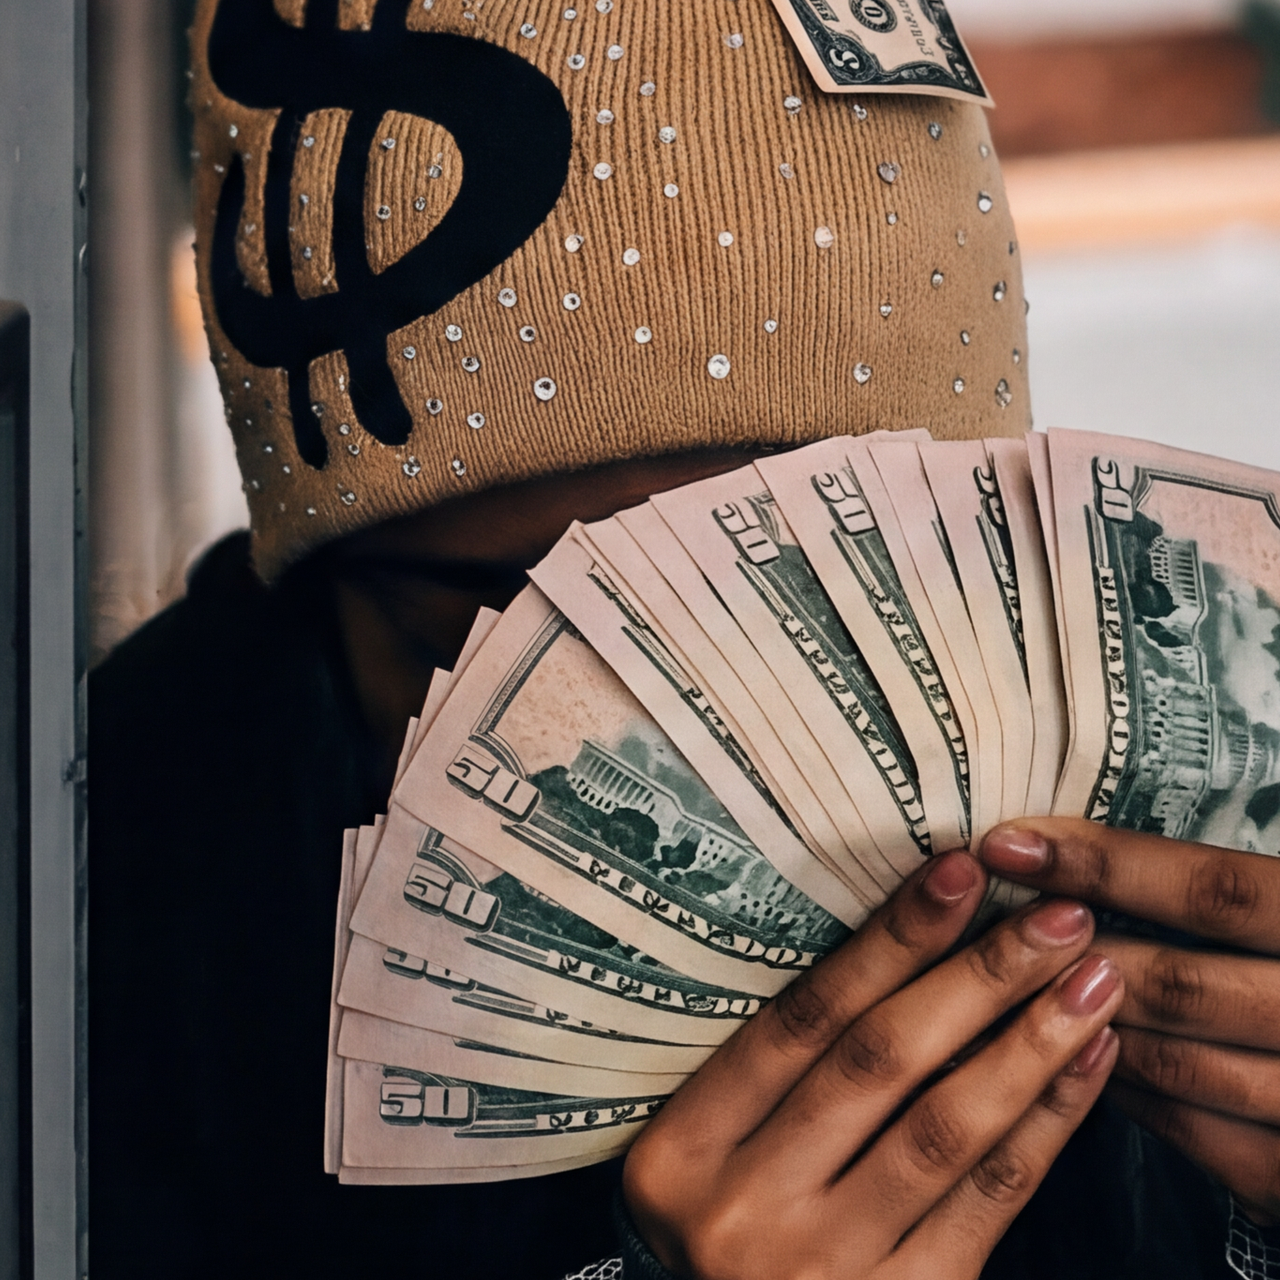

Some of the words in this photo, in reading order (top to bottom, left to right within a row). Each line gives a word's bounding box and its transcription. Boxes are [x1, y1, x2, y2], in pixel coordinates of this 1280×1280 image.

[446, 743, 542, 823] 50
[403, 863, 501, 933] 50
[379, 1081, 477, 1127] 50
